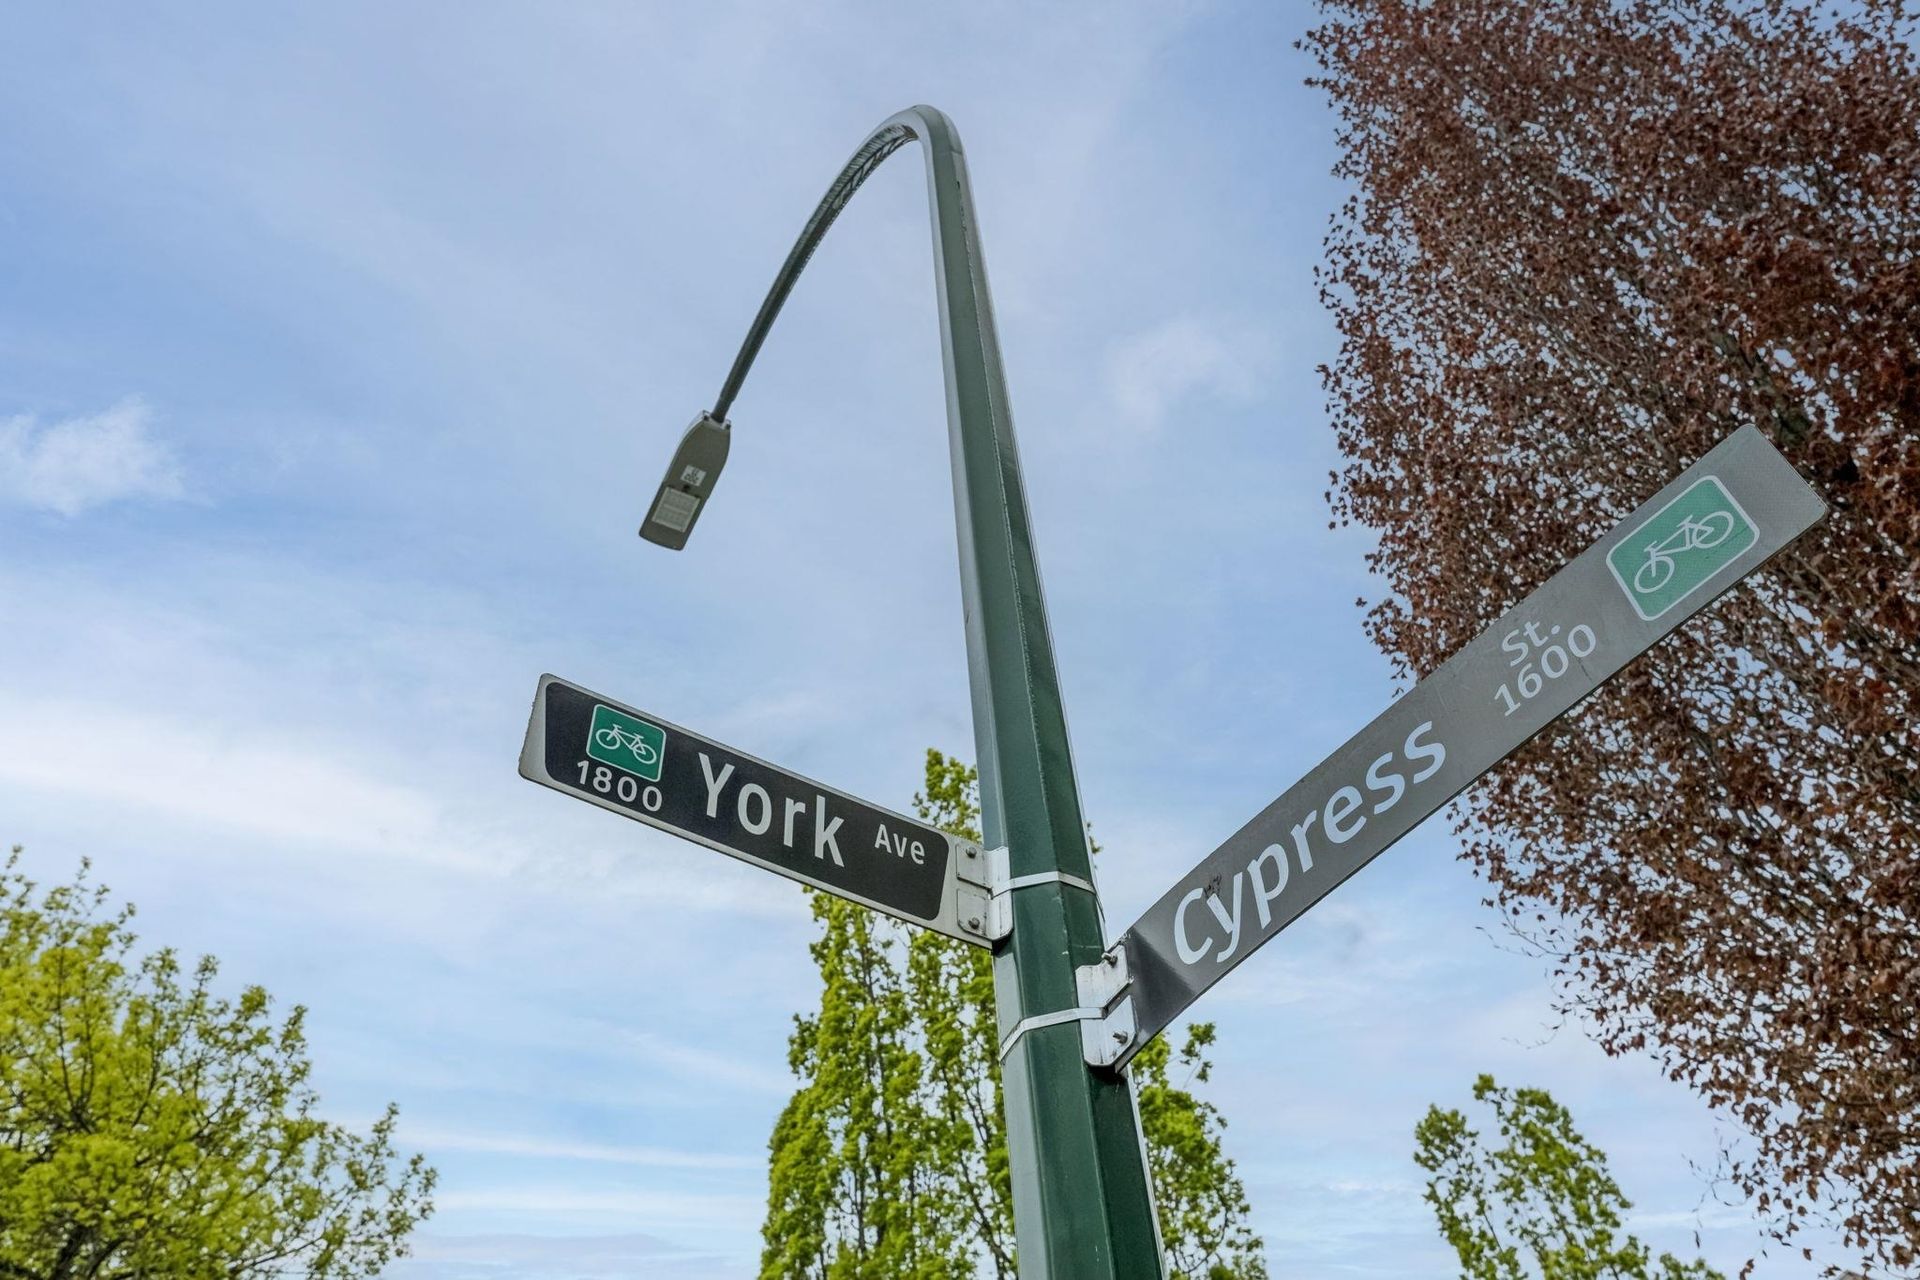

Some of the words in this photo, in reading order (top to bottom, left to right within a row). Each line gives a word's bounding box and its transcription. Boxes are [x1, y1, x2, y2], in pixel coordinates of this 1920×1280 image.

[1494, 624, 1596, 716] 1600
[576, 760, 663, 812] 1800
[698, 752, 845, 868] York
[873, 823, 926, 865] Ave
[1174, 721, 1446, 965] Cypress
[1501, 619, 1561, 667] St.
